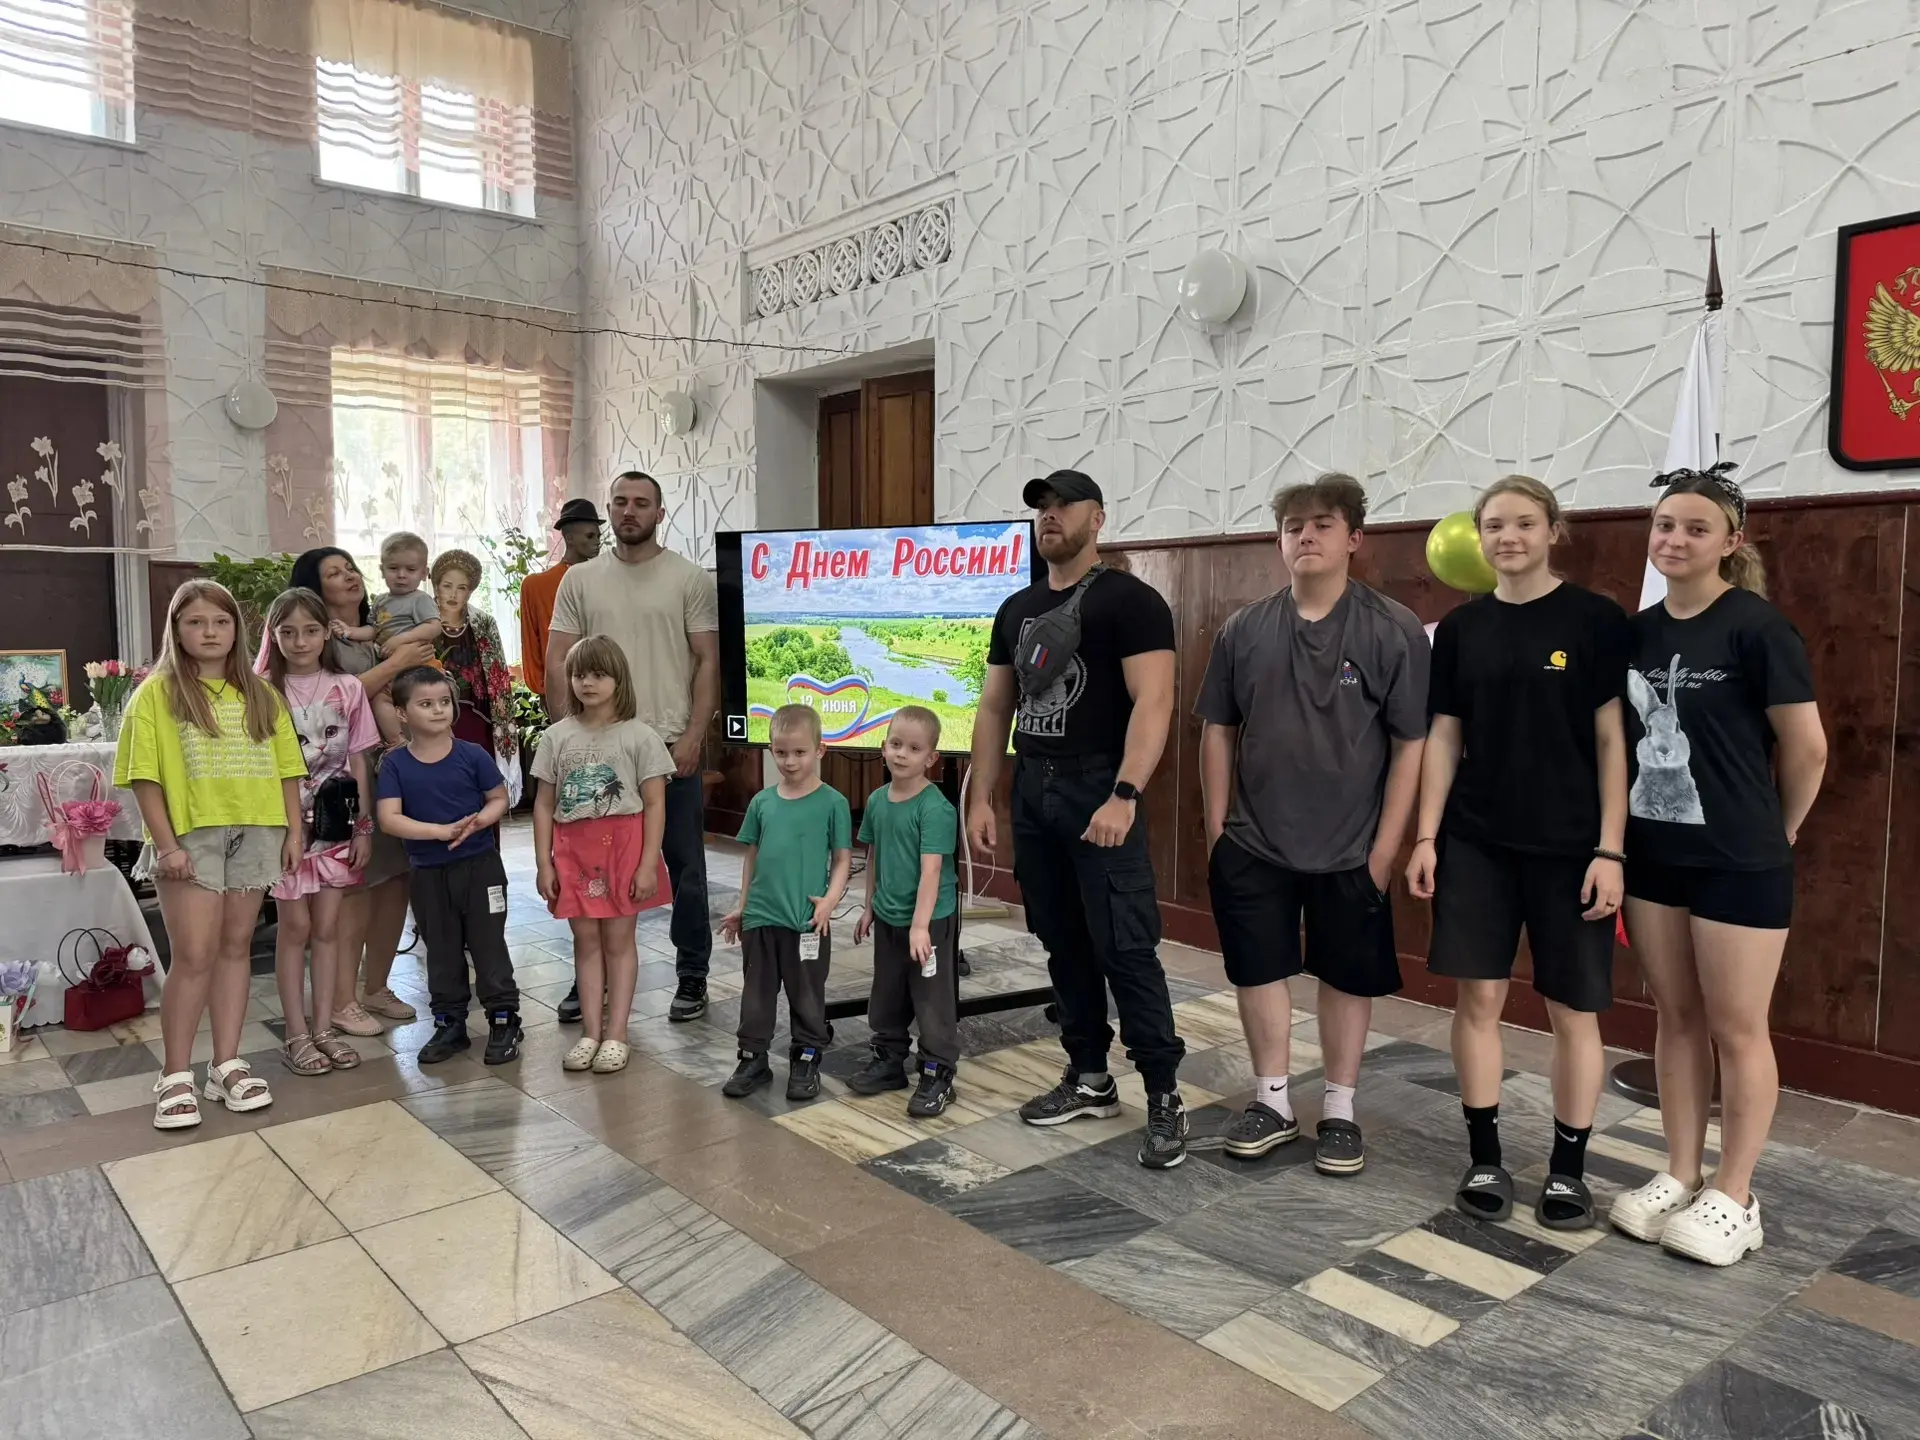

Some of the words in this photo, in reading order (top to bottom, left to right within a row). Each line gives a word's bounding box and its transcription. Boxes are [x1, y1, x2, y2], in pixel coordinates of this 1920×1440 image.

[750, 542, 769, 580] С
[785, 541, 870, 590] Днем
[891, 534, 1023, 577] России!
[1688, 668, 1727, 681] rabbit
[822, 700, 857, 713] июня
[1472, 1174, 1496, 1182] NIKE
